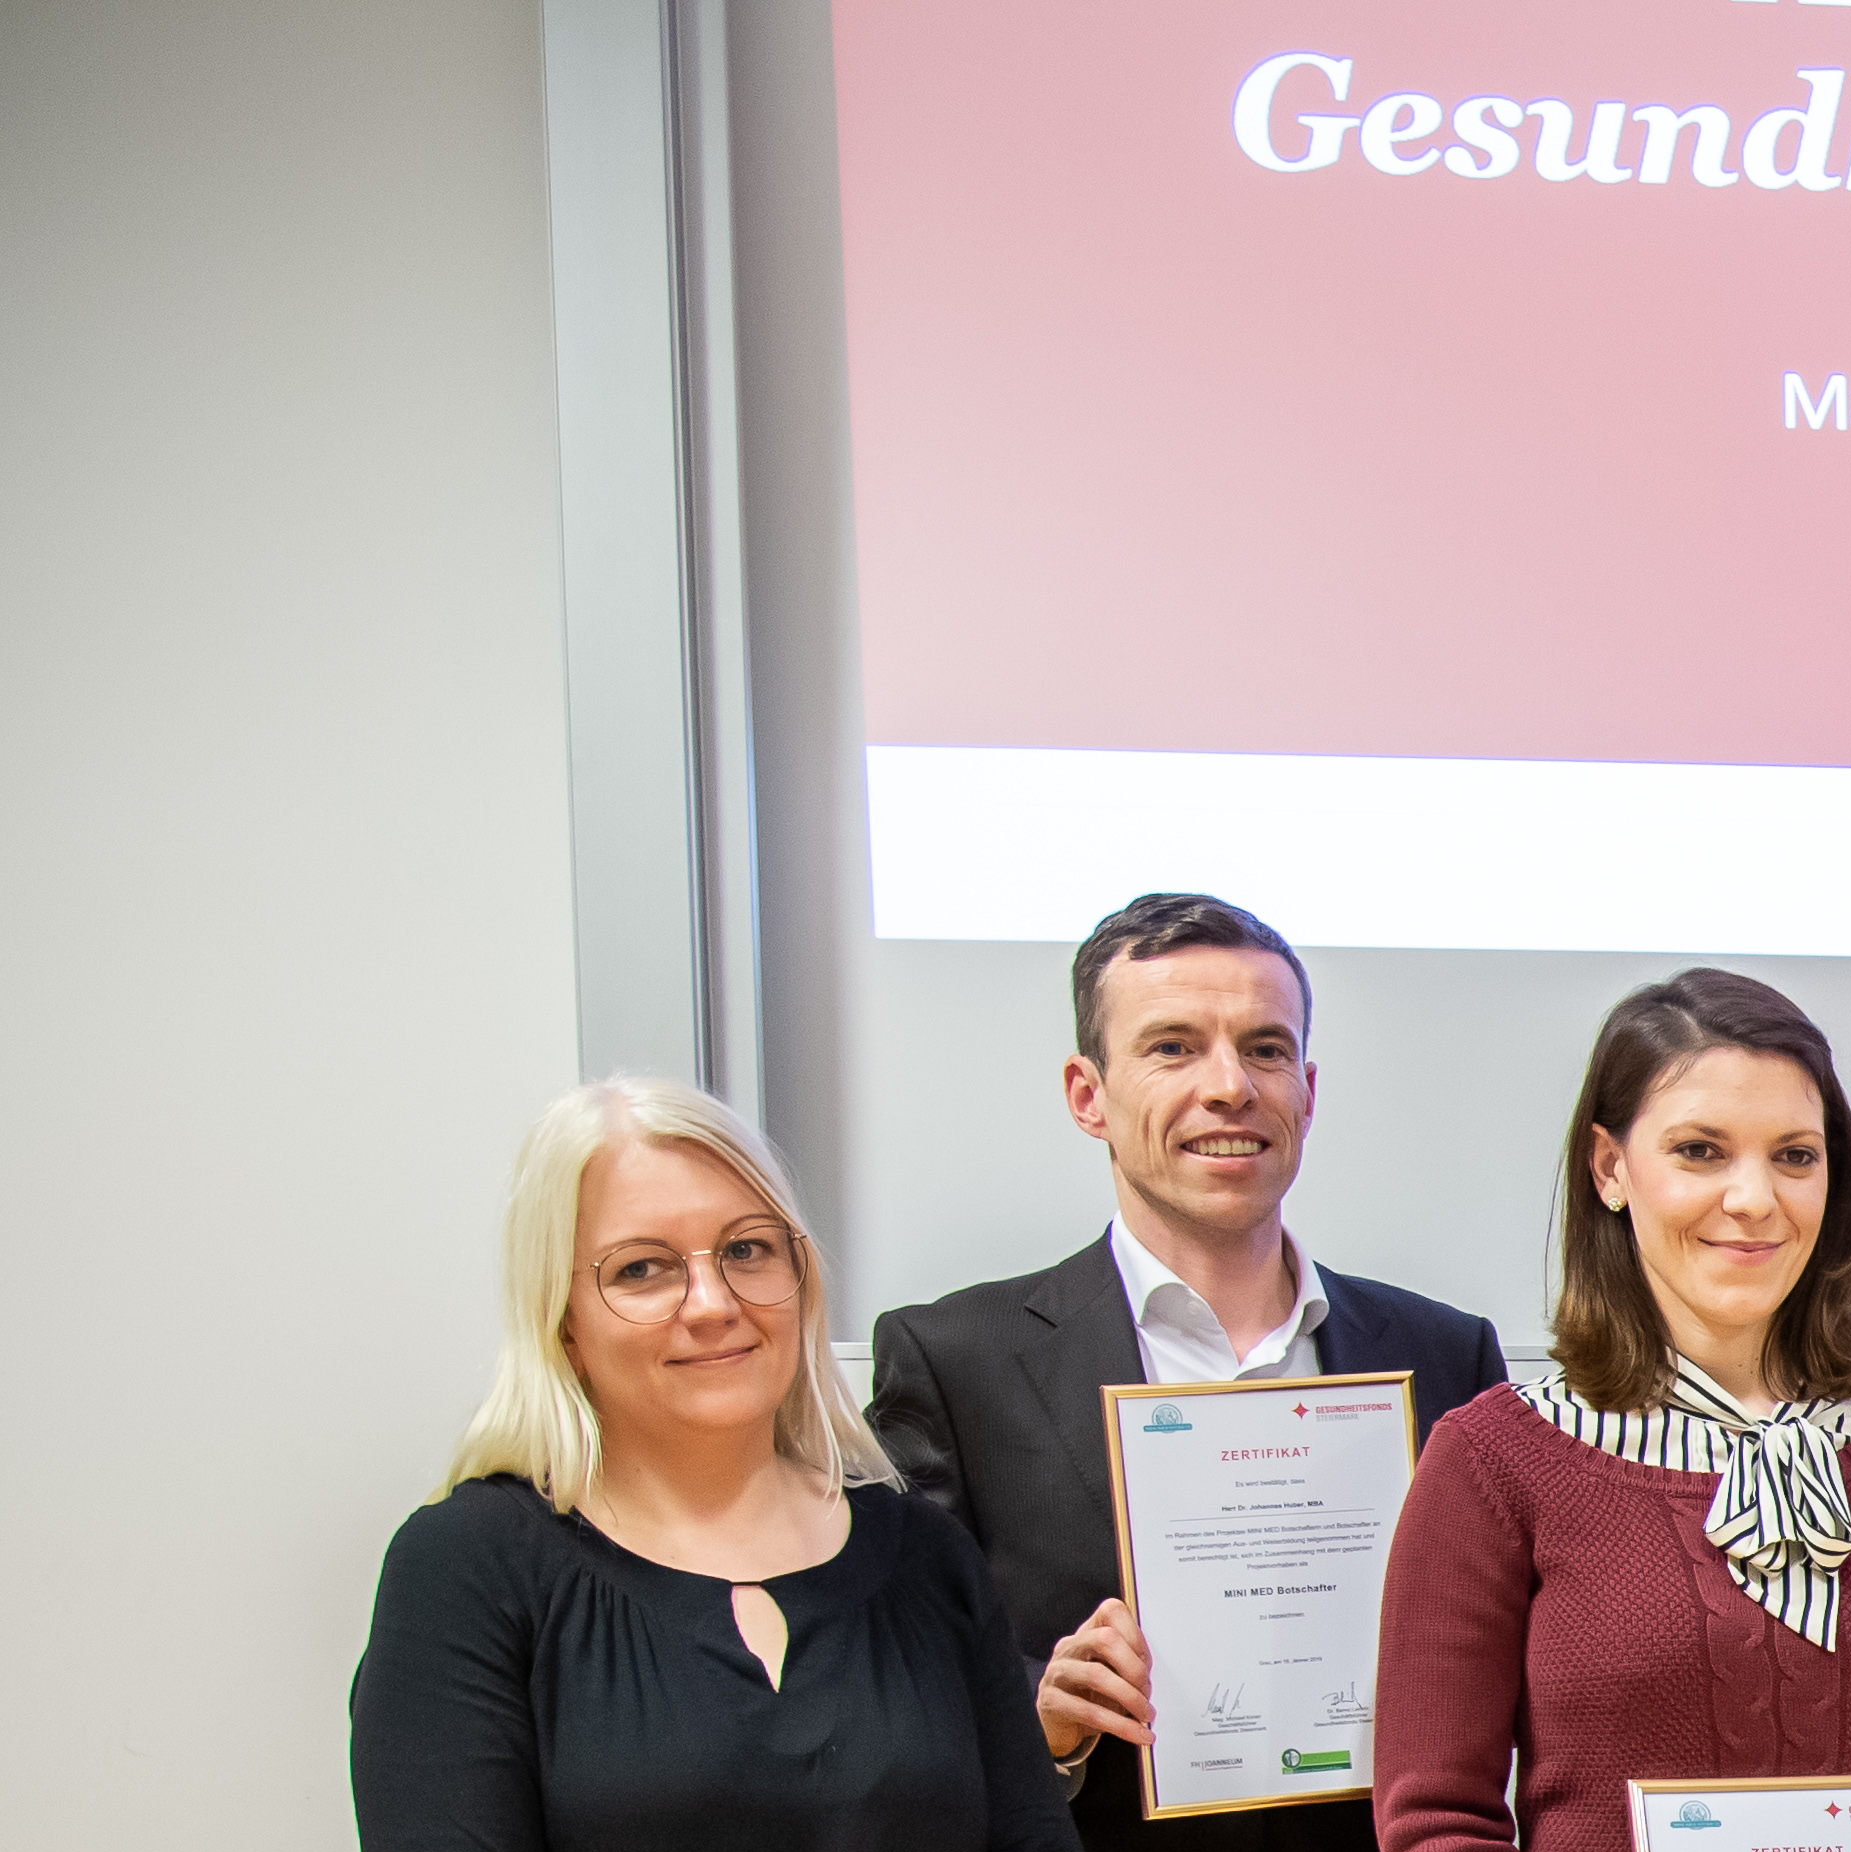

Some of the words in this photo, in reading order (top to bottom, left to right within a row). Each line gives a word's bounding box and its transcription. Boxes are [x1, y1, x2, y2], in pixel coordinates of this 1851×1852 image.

[1314, 1402, 1393, 1414] GESUNDHEITSFONDS
[1219, 1446, 1312, 1461] ZERTIFIKAT
[1224, 1588, 1247, 1599] MINI
[1250, 1586, 1274, 1597] MED
[1277, 1582, 1338, 1596] Botschafter
